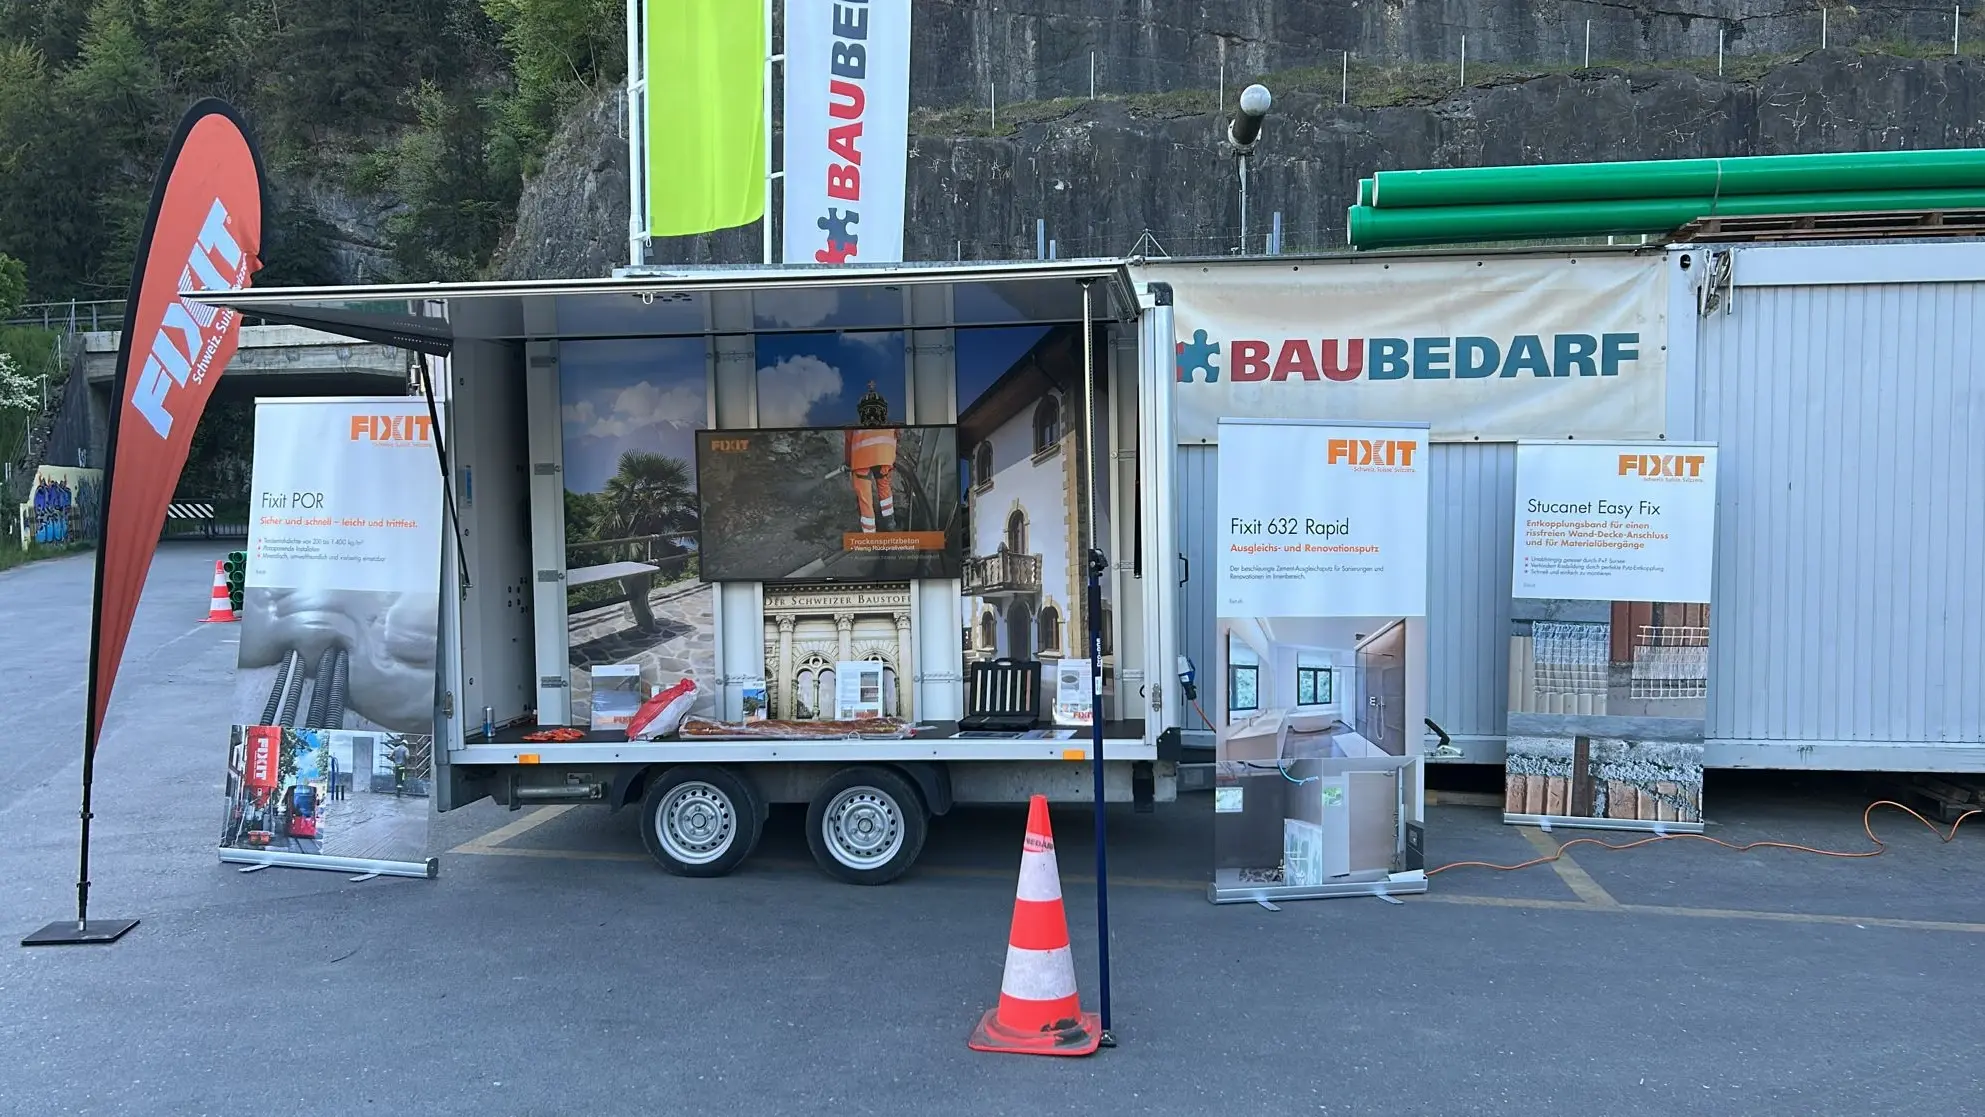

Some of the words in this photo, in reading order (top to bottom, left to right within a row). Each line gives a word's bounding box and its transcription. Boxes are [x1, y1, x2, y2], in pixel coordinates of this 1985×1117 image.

[828, 0, 869, 201] BAUBE
[192, 335, 223, 385] Schweiz.
[215, 308, 235, 333] Suis
[1230, 333, 1639, 382] BAUBEDARF
[350, 415, 433, 441] FIXIT
[711, 439, 749, 451] FIXIT
[1328, 439, 1417, 466] FIXIT
[1618, 454, 1705, 477] FIXIT
[261, 492, 287, 509] Fixit
[292, 492, 325, 509] POR
[1527, 498, 1593, 514] Stucanet
[1598, 499, 1633, 519] Easy
[1639, 500, 1661, 515] Fix
[260, 516, 282, 526] Sicher
[285, 517, 302, 526] und
[305, 517, 332, 527] schnell
[342, 518, 366, 527] leicht
[368, 518, 384, 528] und
[386, 518, 418, 529] trittfest.
[1231, 517, 1263, 535] Fixit
[1267, 517, 1298, 535] 632
[1305, 516, 1349, 540] Rapid
[1526, 519, 1608, 530] Entkopplungsband
[1610, 520, 1623, 529] für
[1625, 521, 1650, 529] einen
[850, 537, 920, 547] Trockenspritzbeton
[1526, 529, 1566, 537] rissfreien
[1568, 530, 1669, 540] Wand-Decke-Anschluss
[1526, 538, 1543, 546] und
[1545, 538, 1559, 547] für
[1560, 539, 1645, 550] Materialübergänge
[1230, 543, 1281, 555] Ausgleichs-
[1284, 543, 1301, 553] und
[1304, 544, 1380, 555] Renovationsputz
[256, 737, 269, 780] FIXIT
